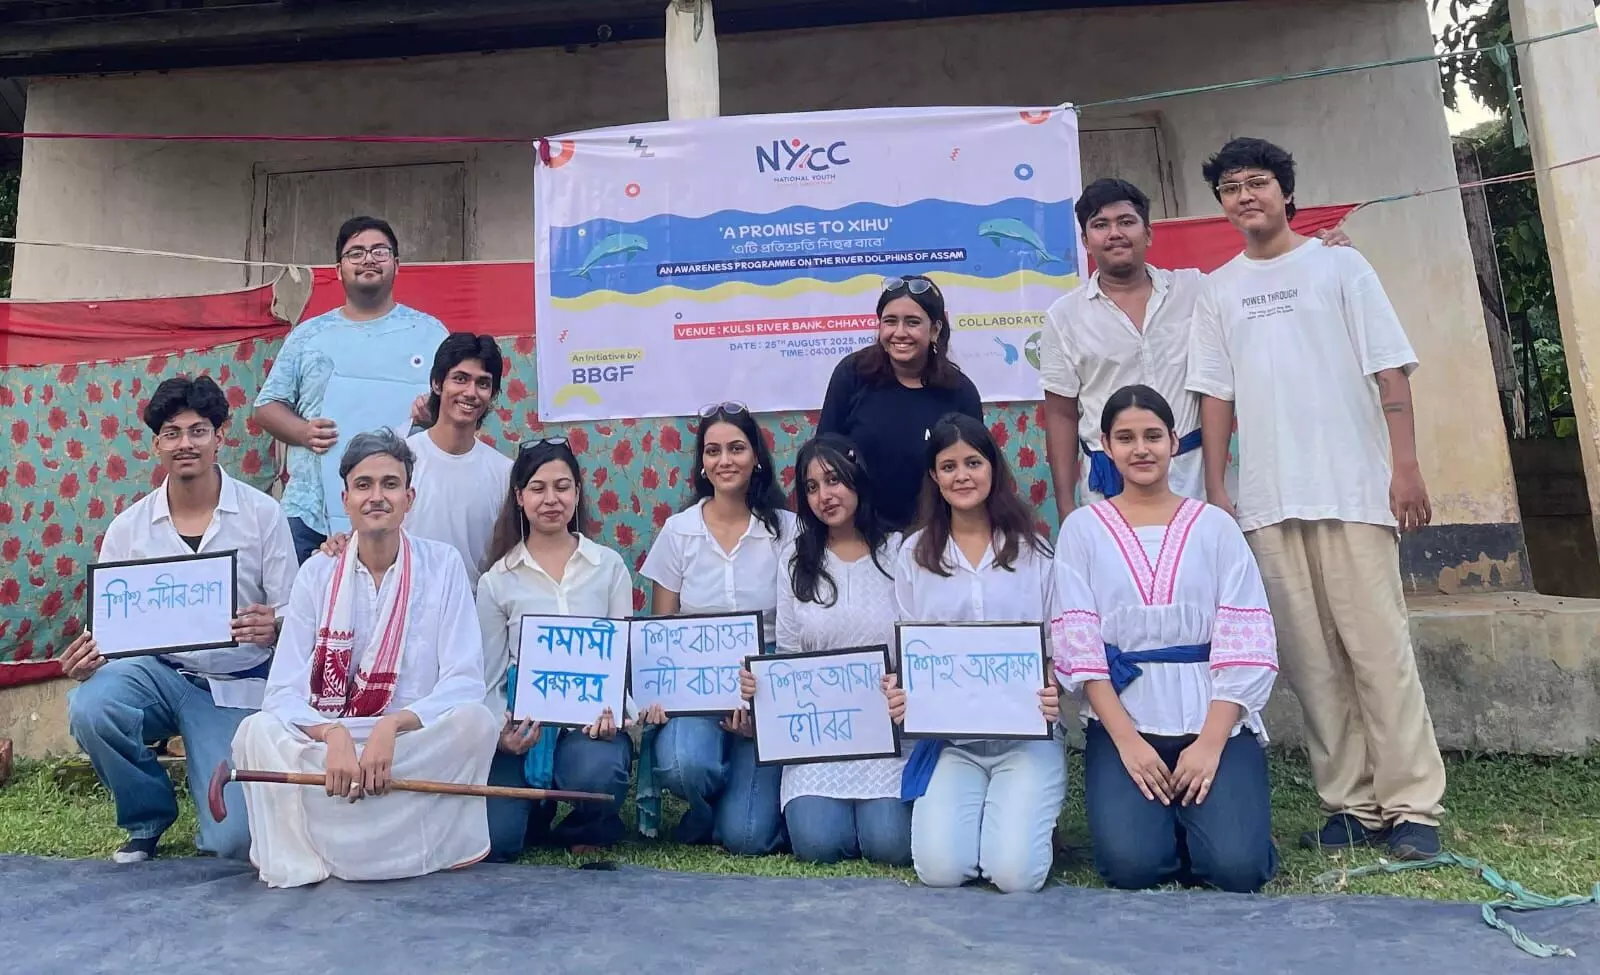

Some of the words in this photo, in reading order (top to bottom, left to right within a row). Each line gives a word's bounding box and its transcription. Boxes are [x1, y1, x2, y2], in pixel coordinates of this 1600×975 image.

[811, 173, 836, 181] YOUTH
[738, 222, 816, 239] PROMISE
[818, 220, 844, 234] TO
[659, 266, 673, 275] AN
[674, 262, 734, 273] AWARENESS
[734, 259, 796, 271] PROGRAMME
[797, 258, 813, 267] ON
[813, 257, 834, 266] THE
[835, 255, 864, 264] RIVER
[864, 252, 914, 263] DOLPHINS
[914, 252, 929, 261] OF
[930, 250, 964, 260] ASSAM
[1241, 295, 1267, 308] POWER
[1267, 288, 1298, 302] THROUGH
[722, 324, 755, 335] KULSI
[756, 322, 790, 333] RIVER
[787, 338, 827, 348] AUGUST
[838, 346, 853, 355] PM
[572, 354, 585, 362] An
[572, 365, 635, 385] BBGF
